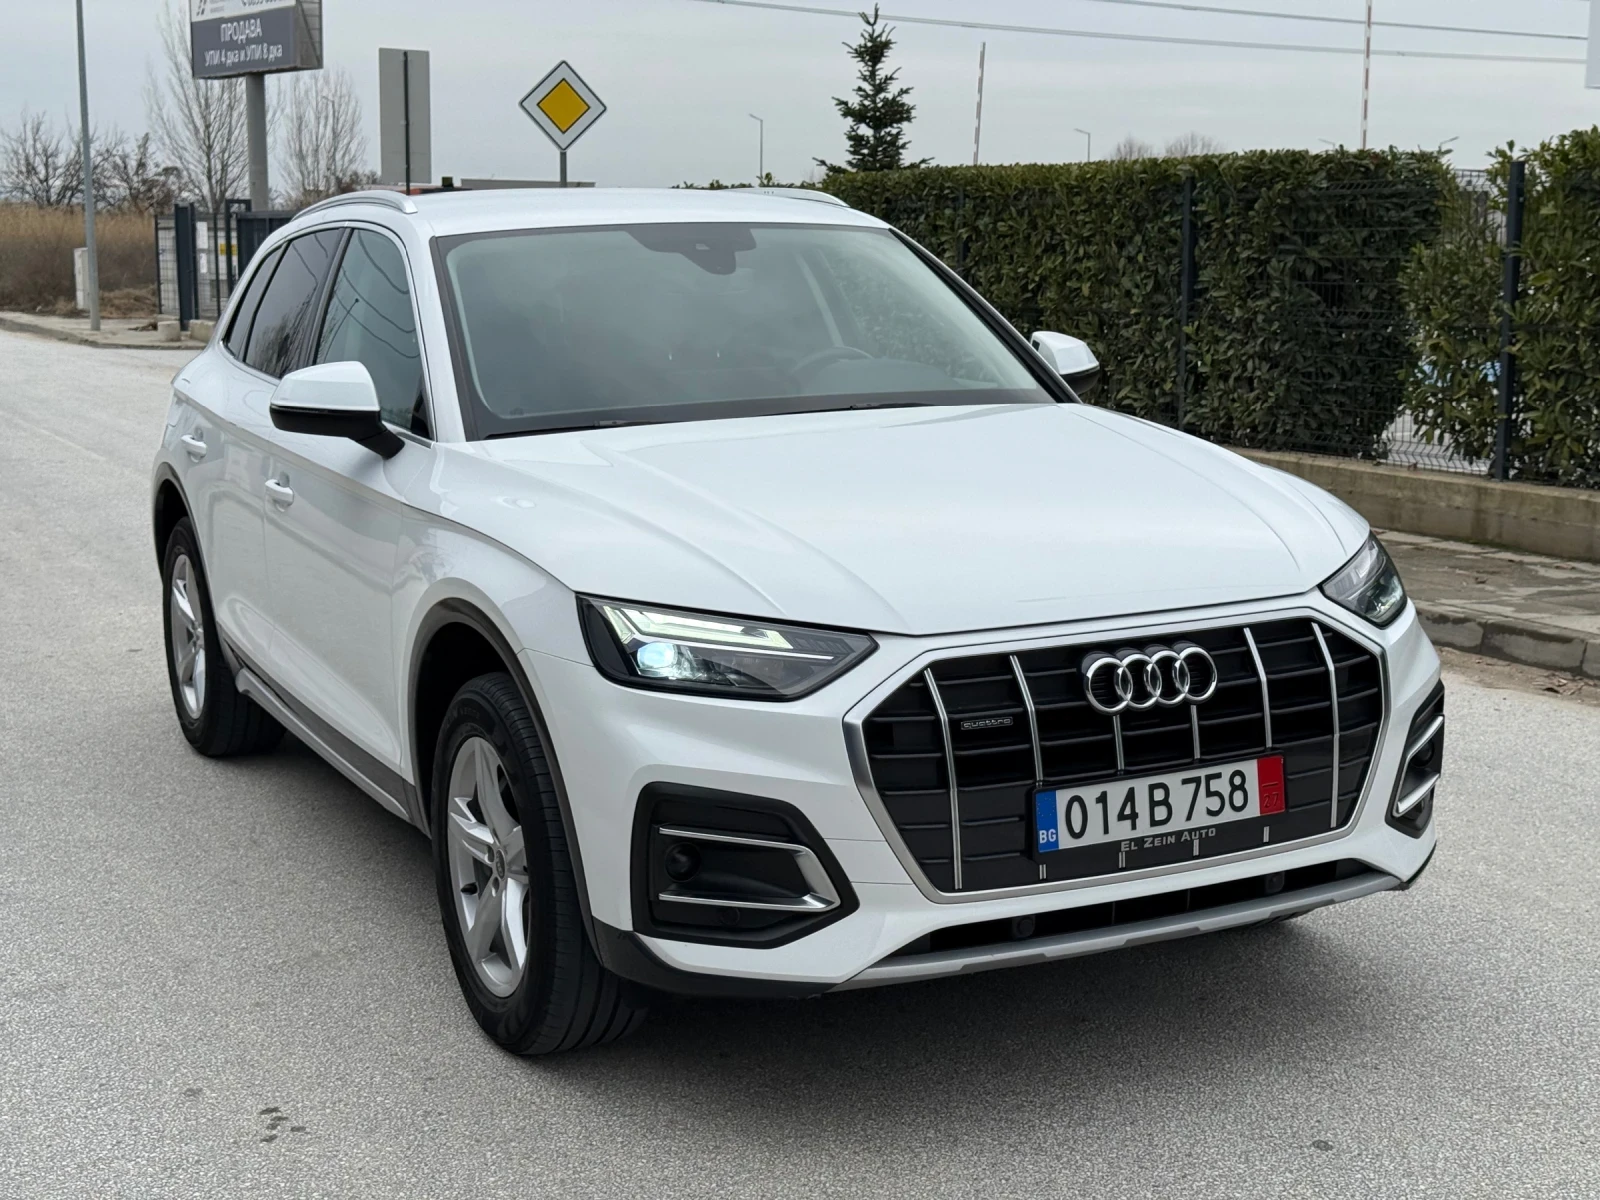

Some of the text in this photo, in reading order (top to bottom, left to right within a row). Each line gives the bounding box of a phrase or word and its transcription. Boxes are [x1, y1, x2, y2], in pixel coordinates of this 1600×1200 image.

[220, 18, 262, 44] ПРОДАВА
[204, 50, 220, 67] УПИ
[220, 49, 226, 64] 4
[240, 49, 246, 62] и
[245, 44, 262, 61] УПИ
[263, 43, 268, 60] 8
[268, 44, 282, 62] дка
[963, 718, 1011, 728] quattro
[1065, 769, 1248, 840] 014B758
[1039, 829, 1057, 843] BG
